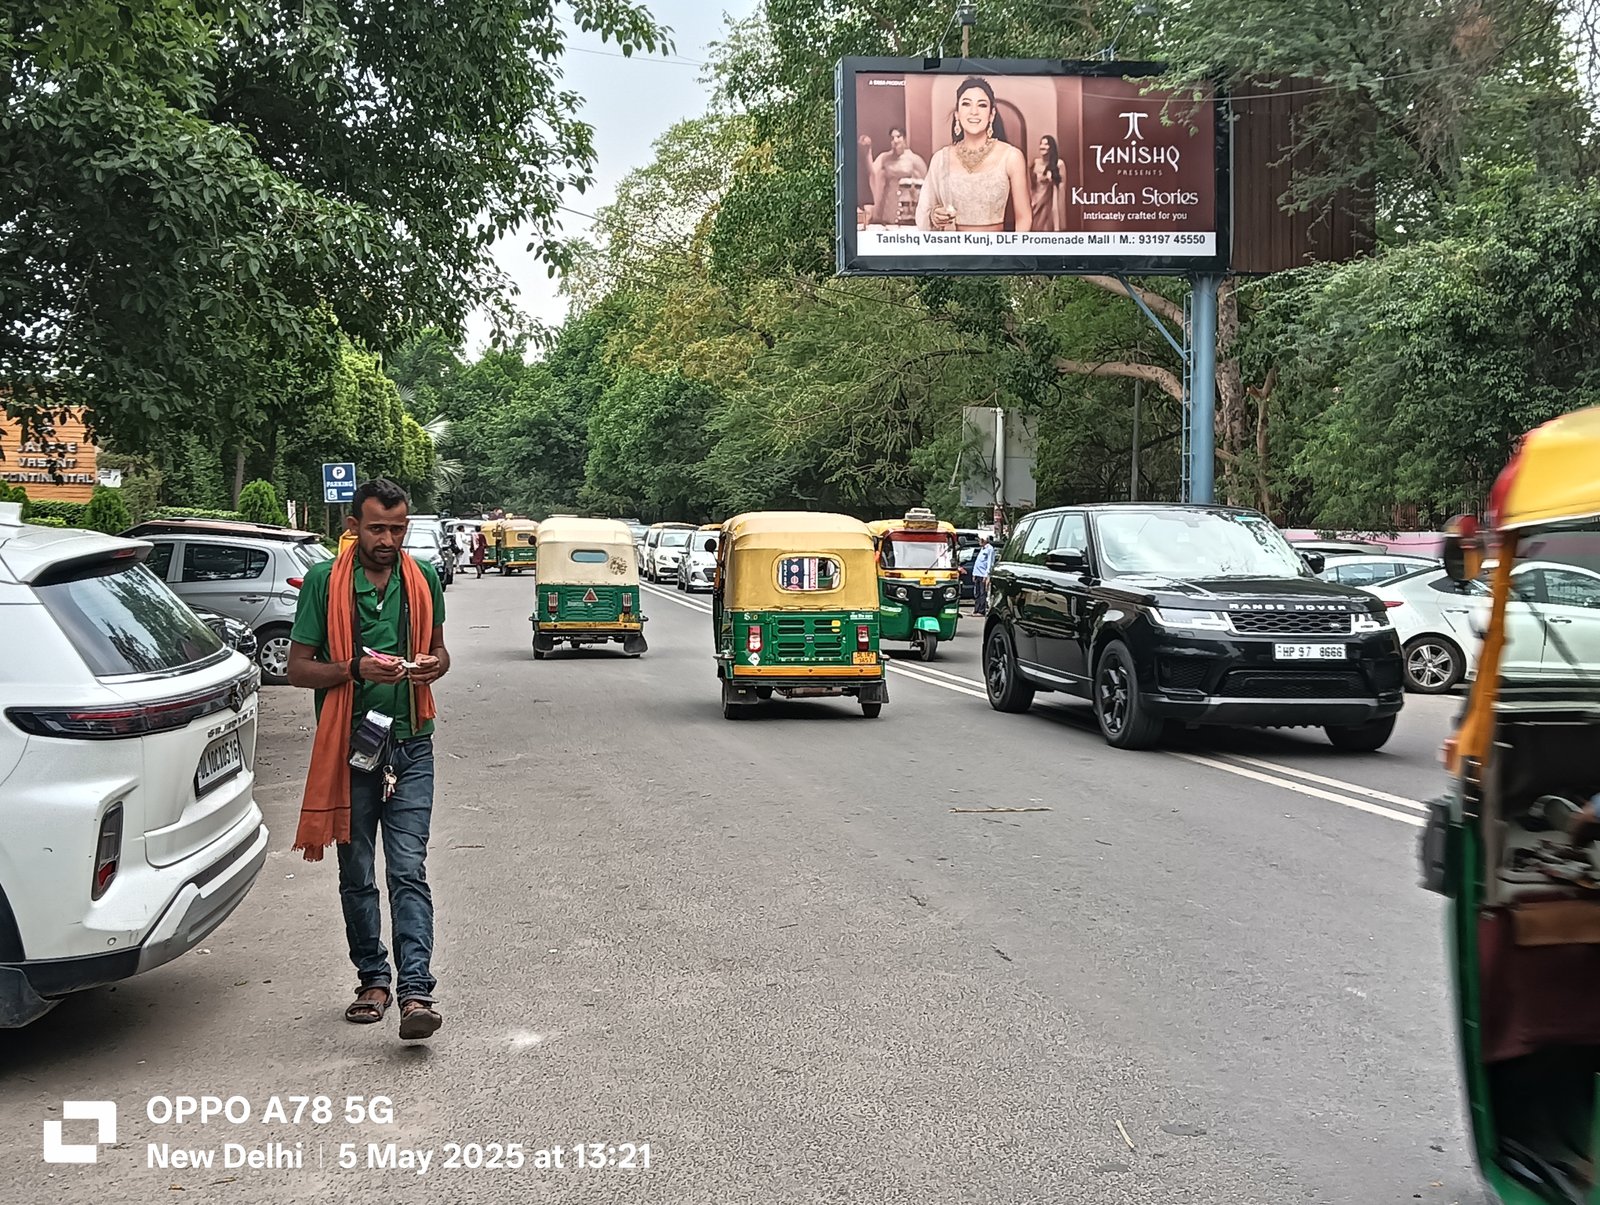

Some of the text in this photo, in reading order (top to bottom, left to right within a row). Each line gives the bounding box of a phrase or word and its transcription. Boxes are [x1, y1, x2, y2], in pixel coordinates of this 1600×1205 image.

[1089, 140, 1180, 173] TANISHQ
[1071, 182, 1199, 207] Kundan Stories
[1083, 211, 1188, 222] Intricately crafted for you
[876, 233, 1206, 247] Tanishq Vasant Kunj, DLF Promenade Mall M.: 93197 45550
[19, 457, 76, 468] VASNT
[1283, 646, 1295, 657] HP
